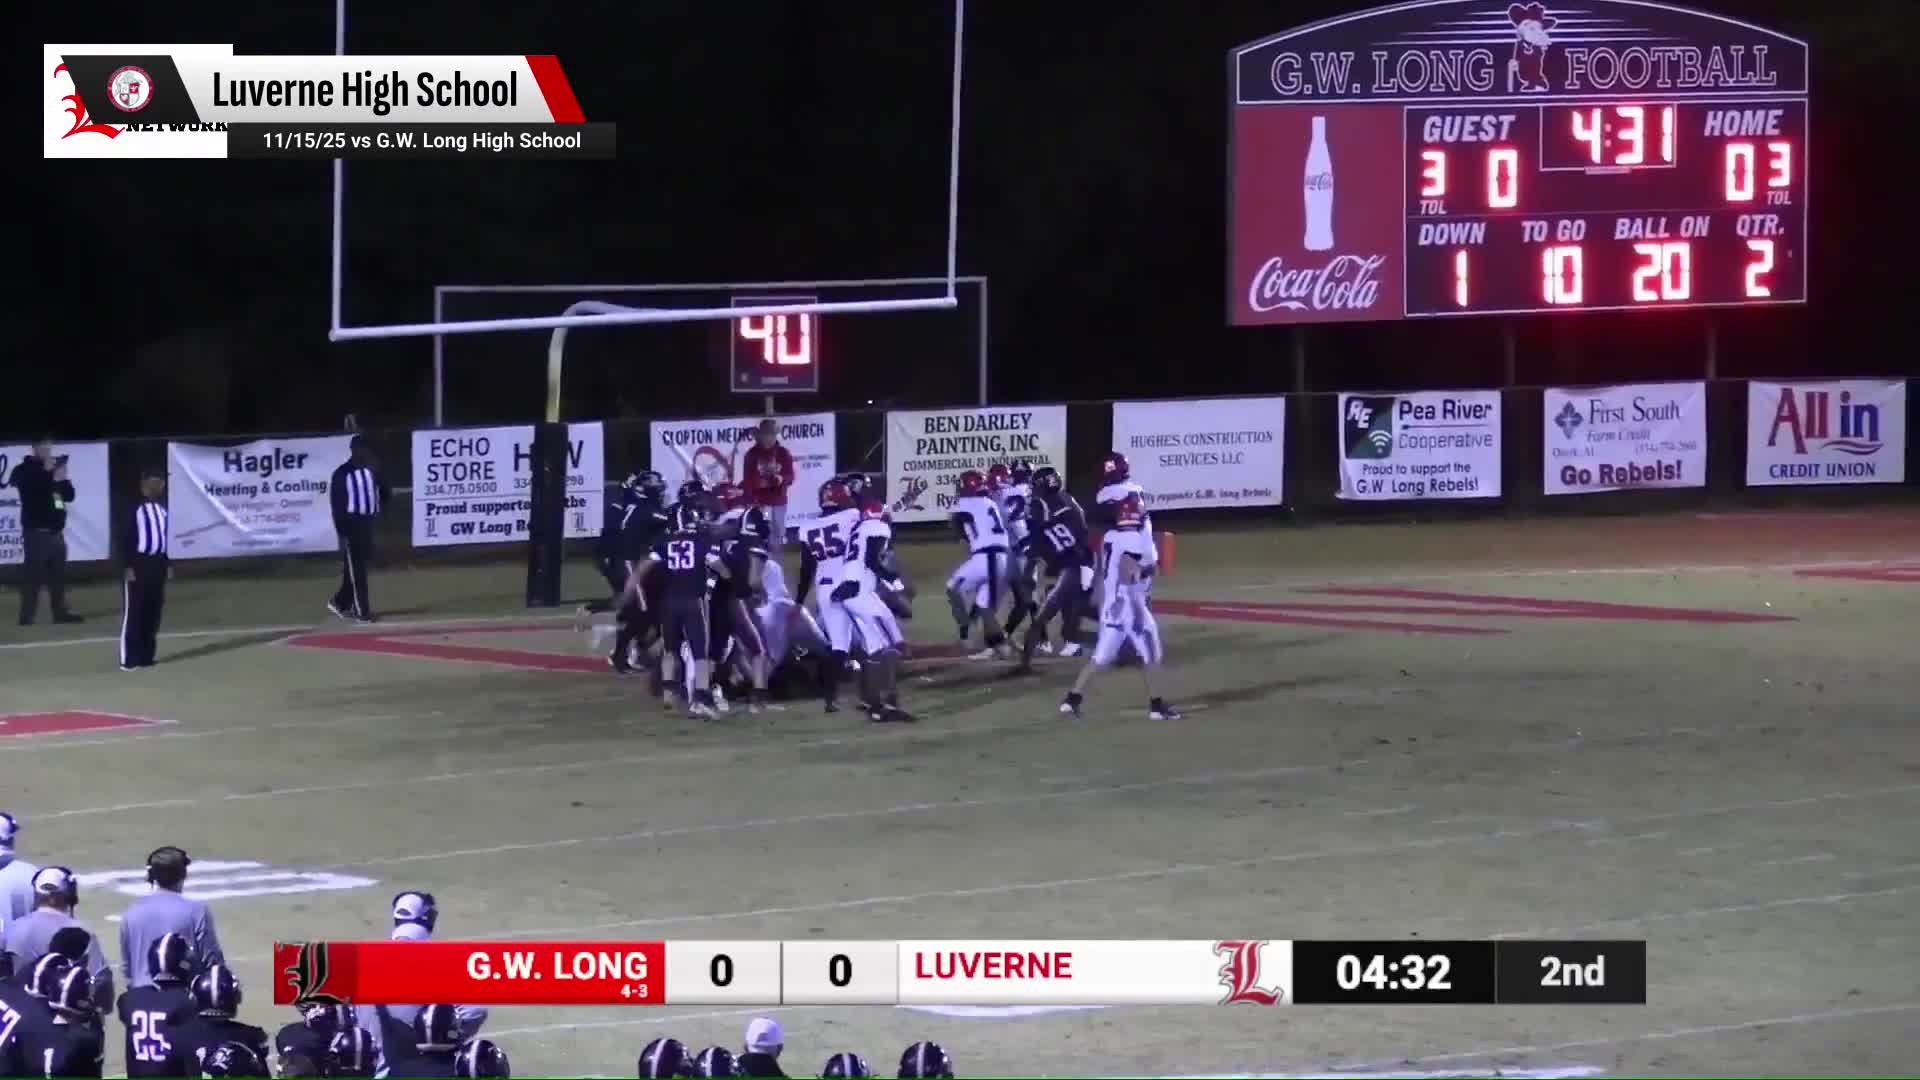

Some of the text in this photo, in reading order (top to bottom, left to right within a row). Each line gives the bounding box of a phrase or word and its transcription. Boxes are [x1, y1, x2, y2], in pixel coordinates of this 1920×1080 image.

[1271, 48, 1495, 95] G.W. LONG
[1565, 45, 1777, 89] FOOTBALL
[1423, 114, 1516, 142] GUEST
[1572, 107, 1673, 164] 4:31
[1703, 109, 1784, 136] HOME
[1421, 151, 1446, 196] 3
[1725, 143, 1755, 201] 0
[1767, 142, 1791, 187] 3
[1488, 149, 1518, 208] 0
[1420, 200, 1447, 215] TOL
[1767, 190, 1792, 205] TOL
[1418, 222, 1486, 246] DOWN
[1521, 219, 1587, 243] TO GO
[1614, 215, 1710, 240] BALL ON
[1736, 213, 1785, 237] QTR.
[1456, 249, 1468, 307] 1
[1543, 246, 1583, 304] 10
[1632, 242, 1690, 301] 20
[1745, 239, 1774, 297] 2
[1249, 253, 1387, 312] Coca-Cola
[740, 313, 811, 364] 40
[1400, 399, 1493, 420] Pea River
[1588, 396, 1681, 426] First South
[1767, 388, 1880, 455] All in
[663, 429, 713, 446] CLOPTON
[781, 423, 825, 440] CHURCH
[924, 413, 1032, 434] BEN DARLEY
[430, 437, 490, 459] ECHO
[916, 434, 1040, 456] PAINTING, INC
[1130, 431, 1273, 448] HUGHES CONSTRUCTION
[1398, 432, 1493, 453] Cooperative
[223, 448, 309, 478] Hagler
[427, 460, 496, 483] STORE
[903, 457, 975, 472] COMMERCIAL
[976, 457, 985, 468] &
[1159, 451, 1245, 468] SERVICES LLC
[1362, 462, 1471, 476] Proud to support the
[1769, 462, 1876, 479] CREDIT UNION
[1392, 478, 1425, 496] Long
[1430, 476, 1479, 492] Rebels!
[1560, 460, 1683, 486] Go Rebels!
[204, 479, 328, 498] Heating & Cooling
[426, 501, 467, 516] Proud
[471, 499, 531, 514] supporte
[451, 521, 476, 536] GW
[479, 520, 512, 536] Long
[1043, 523, 1077, 551] 19
[667, 540, 695, 569] 53
[807, 523, 846, 560] 55
[131, 1010, 171, 1062] 25
